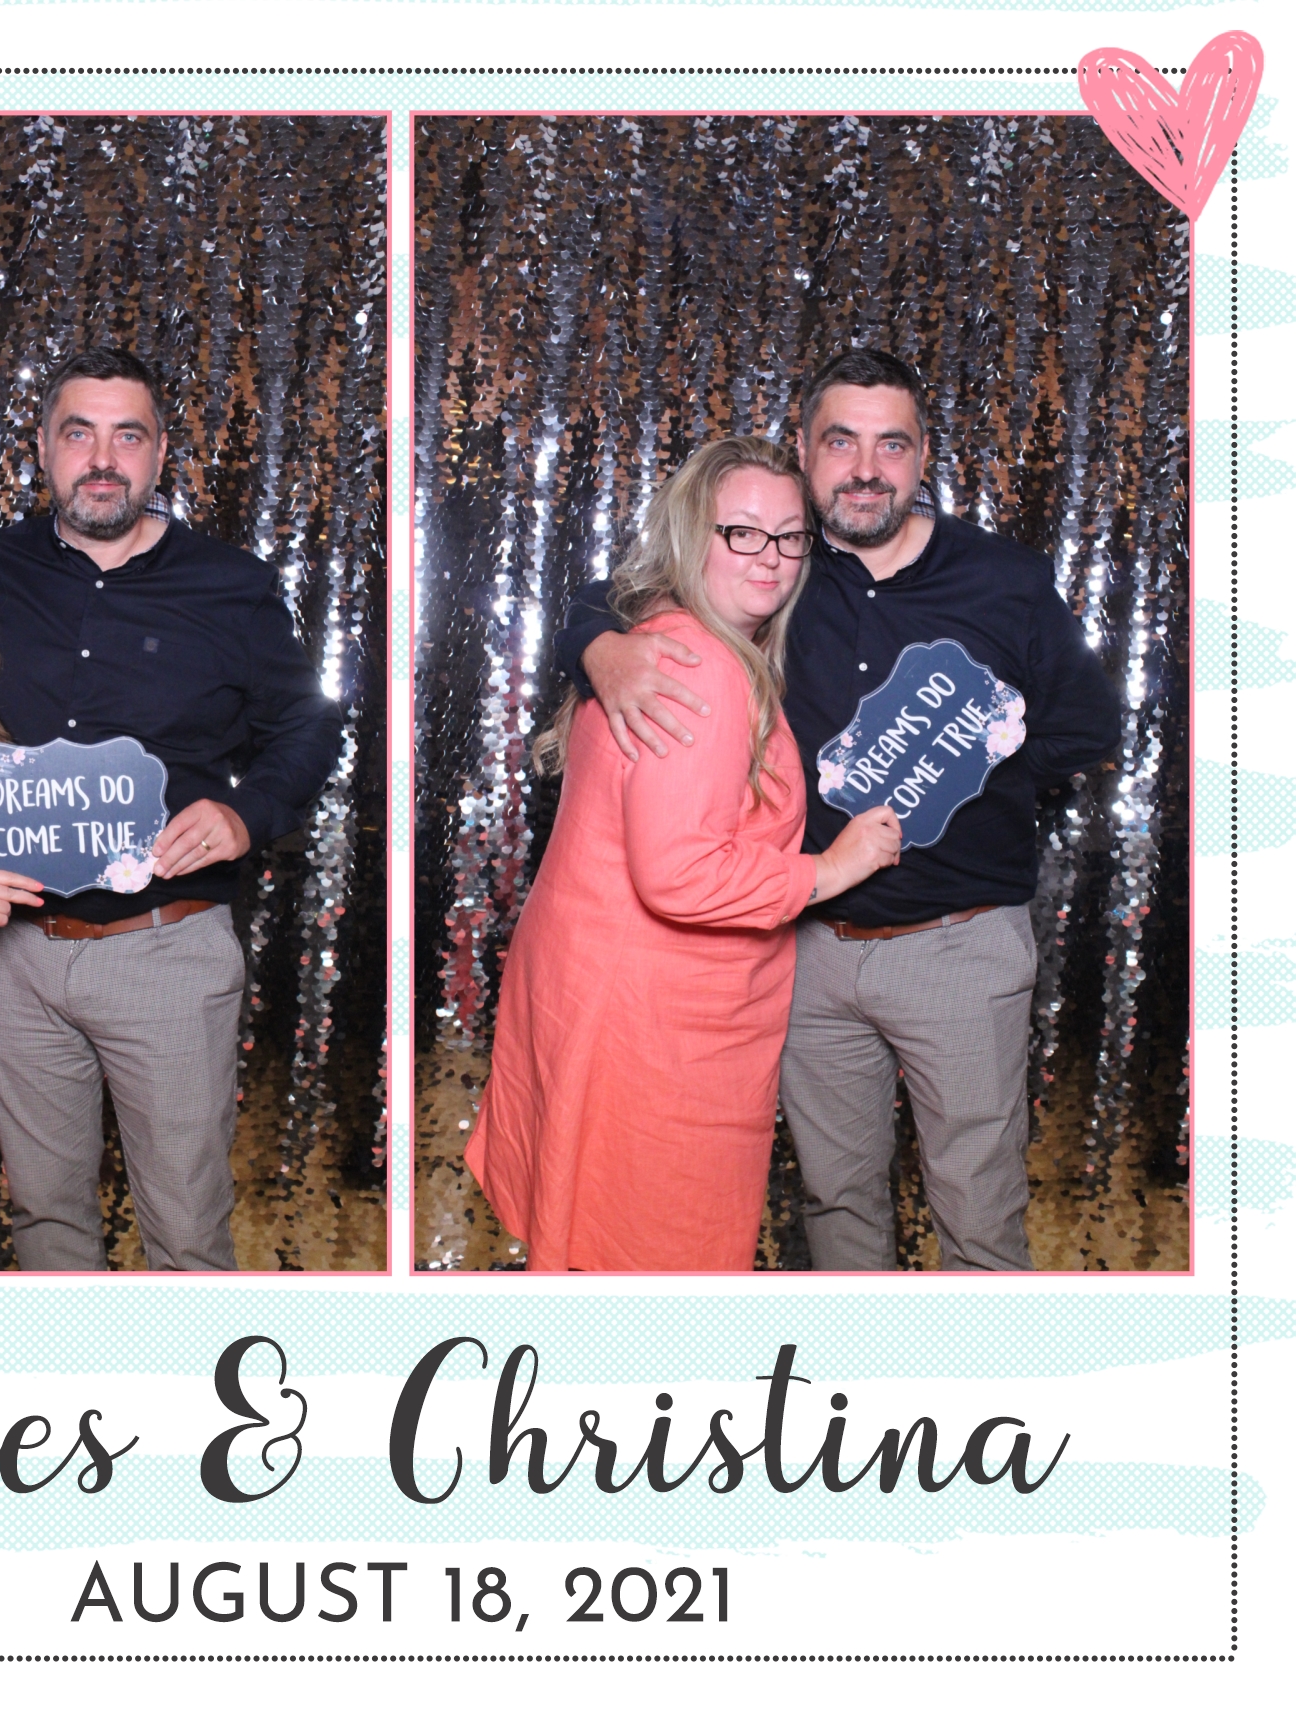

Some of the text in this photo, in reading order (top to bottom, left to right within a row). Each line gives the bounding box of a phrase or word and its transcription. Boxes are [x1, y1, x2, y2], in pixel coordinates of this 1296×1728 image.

[846, 671, 956, 794] DREAMS DO
[931, 697, 993, 758] TRUE
[99, 774, 135, 805] DO
[72, 820, 138, 857] TRUE
